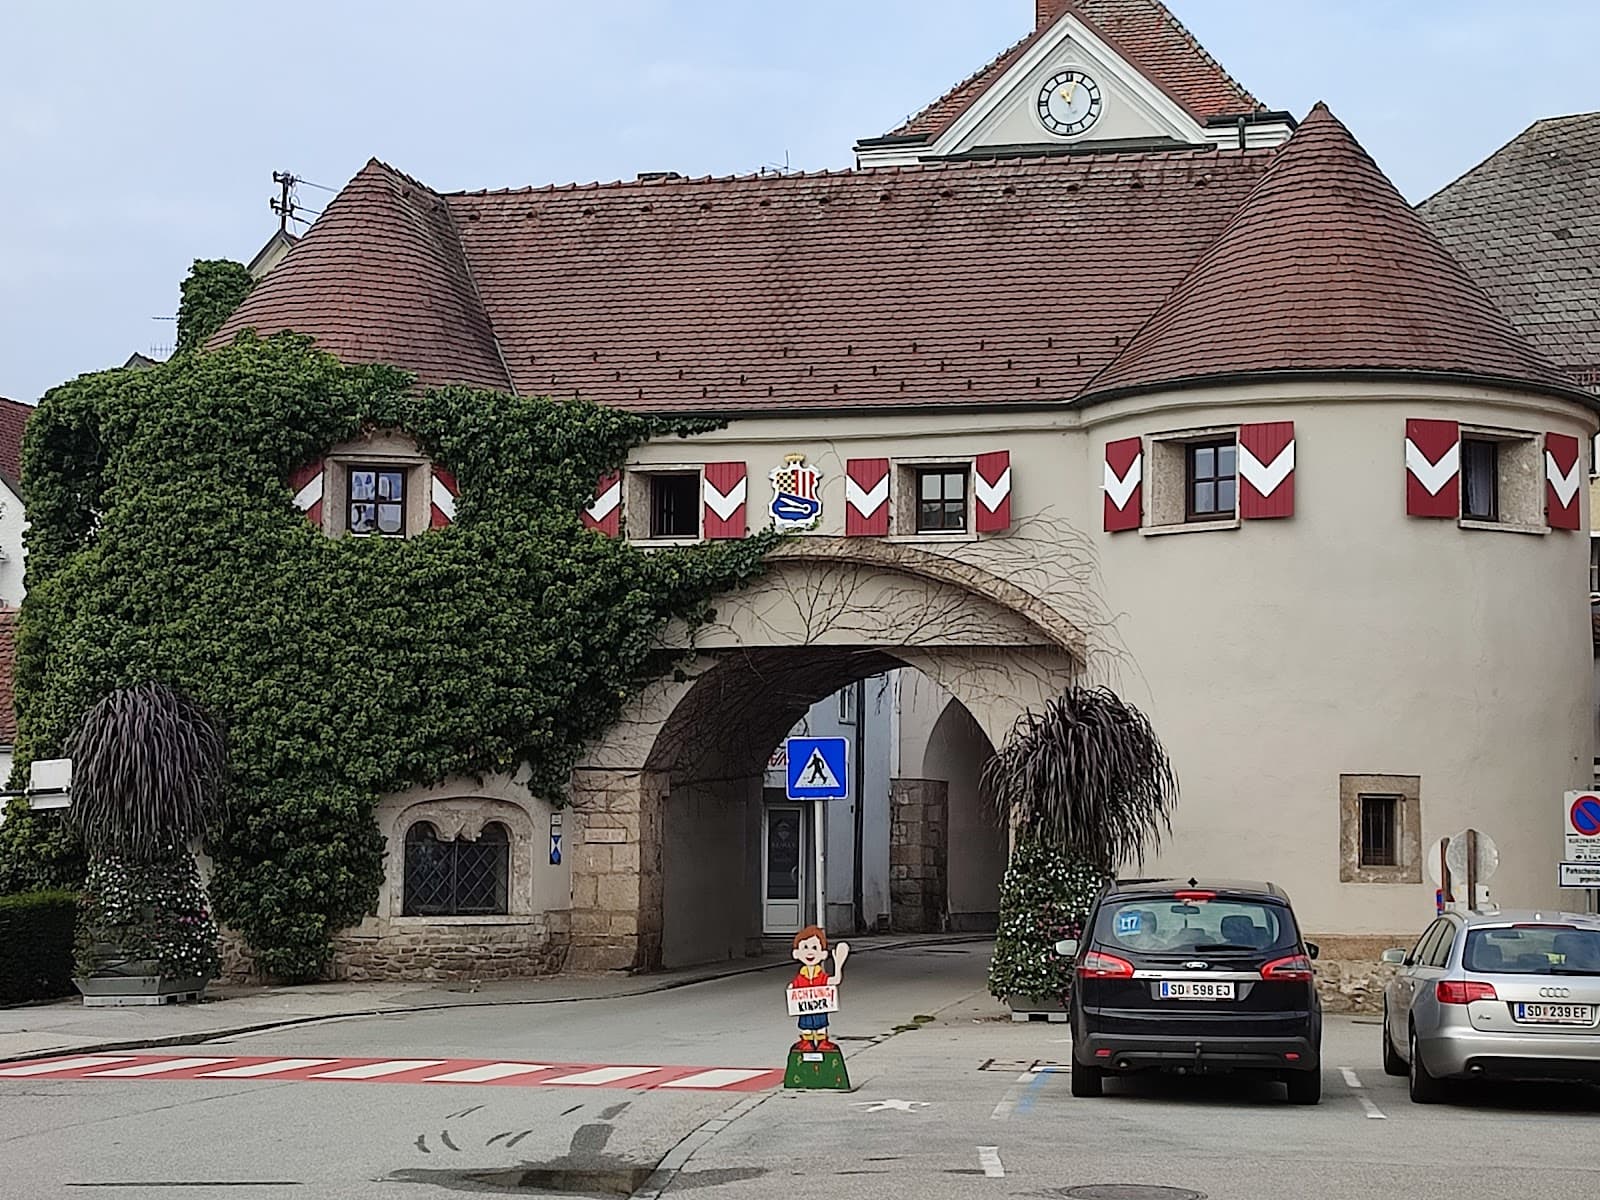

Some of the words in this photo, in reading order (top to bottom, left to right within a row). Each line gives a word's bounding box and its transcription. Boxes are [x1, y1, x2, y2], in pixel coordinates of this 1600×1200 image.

[1170, 984, 1185, 995] SD
[1192, 984, 1214, 996] 598
[1216, 985, 1230, 996] EJ
[1527, 1005, 1542, 1017] SD
[1550, 1006, 1571, 1018] 239
[1573, 1007, 1588, 1018] EF
